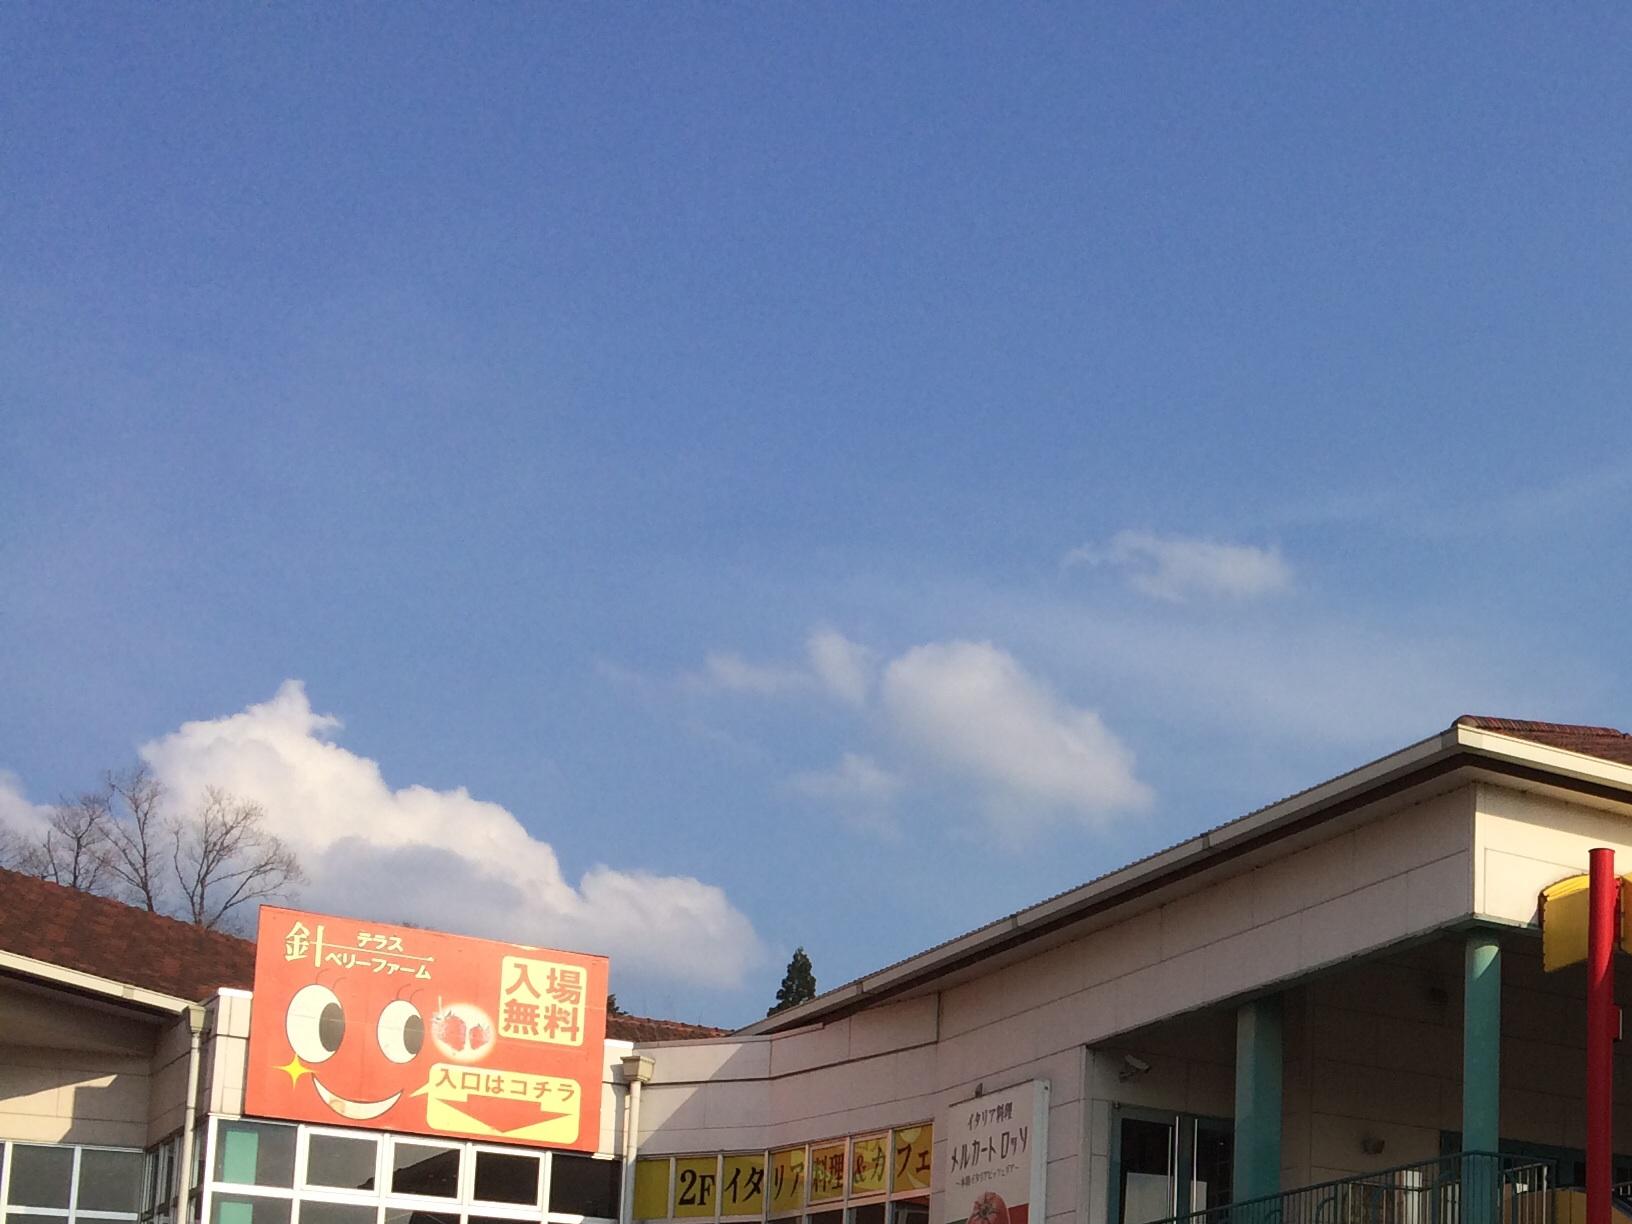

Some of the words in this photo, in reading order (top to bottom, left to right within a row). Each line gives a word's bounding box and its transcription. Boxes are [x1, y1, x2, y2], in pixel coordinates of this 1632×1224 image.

[283, 920, 326, 968] 針
[357, 931, 405, 953] テラス
[325, 951, 432, 981] ベリーファーム
[505, 961, 583, 1006] 入場
[502, 999, 580, 1042] 無料
[434, 1068, 577, 1103] 入口はコチラ
